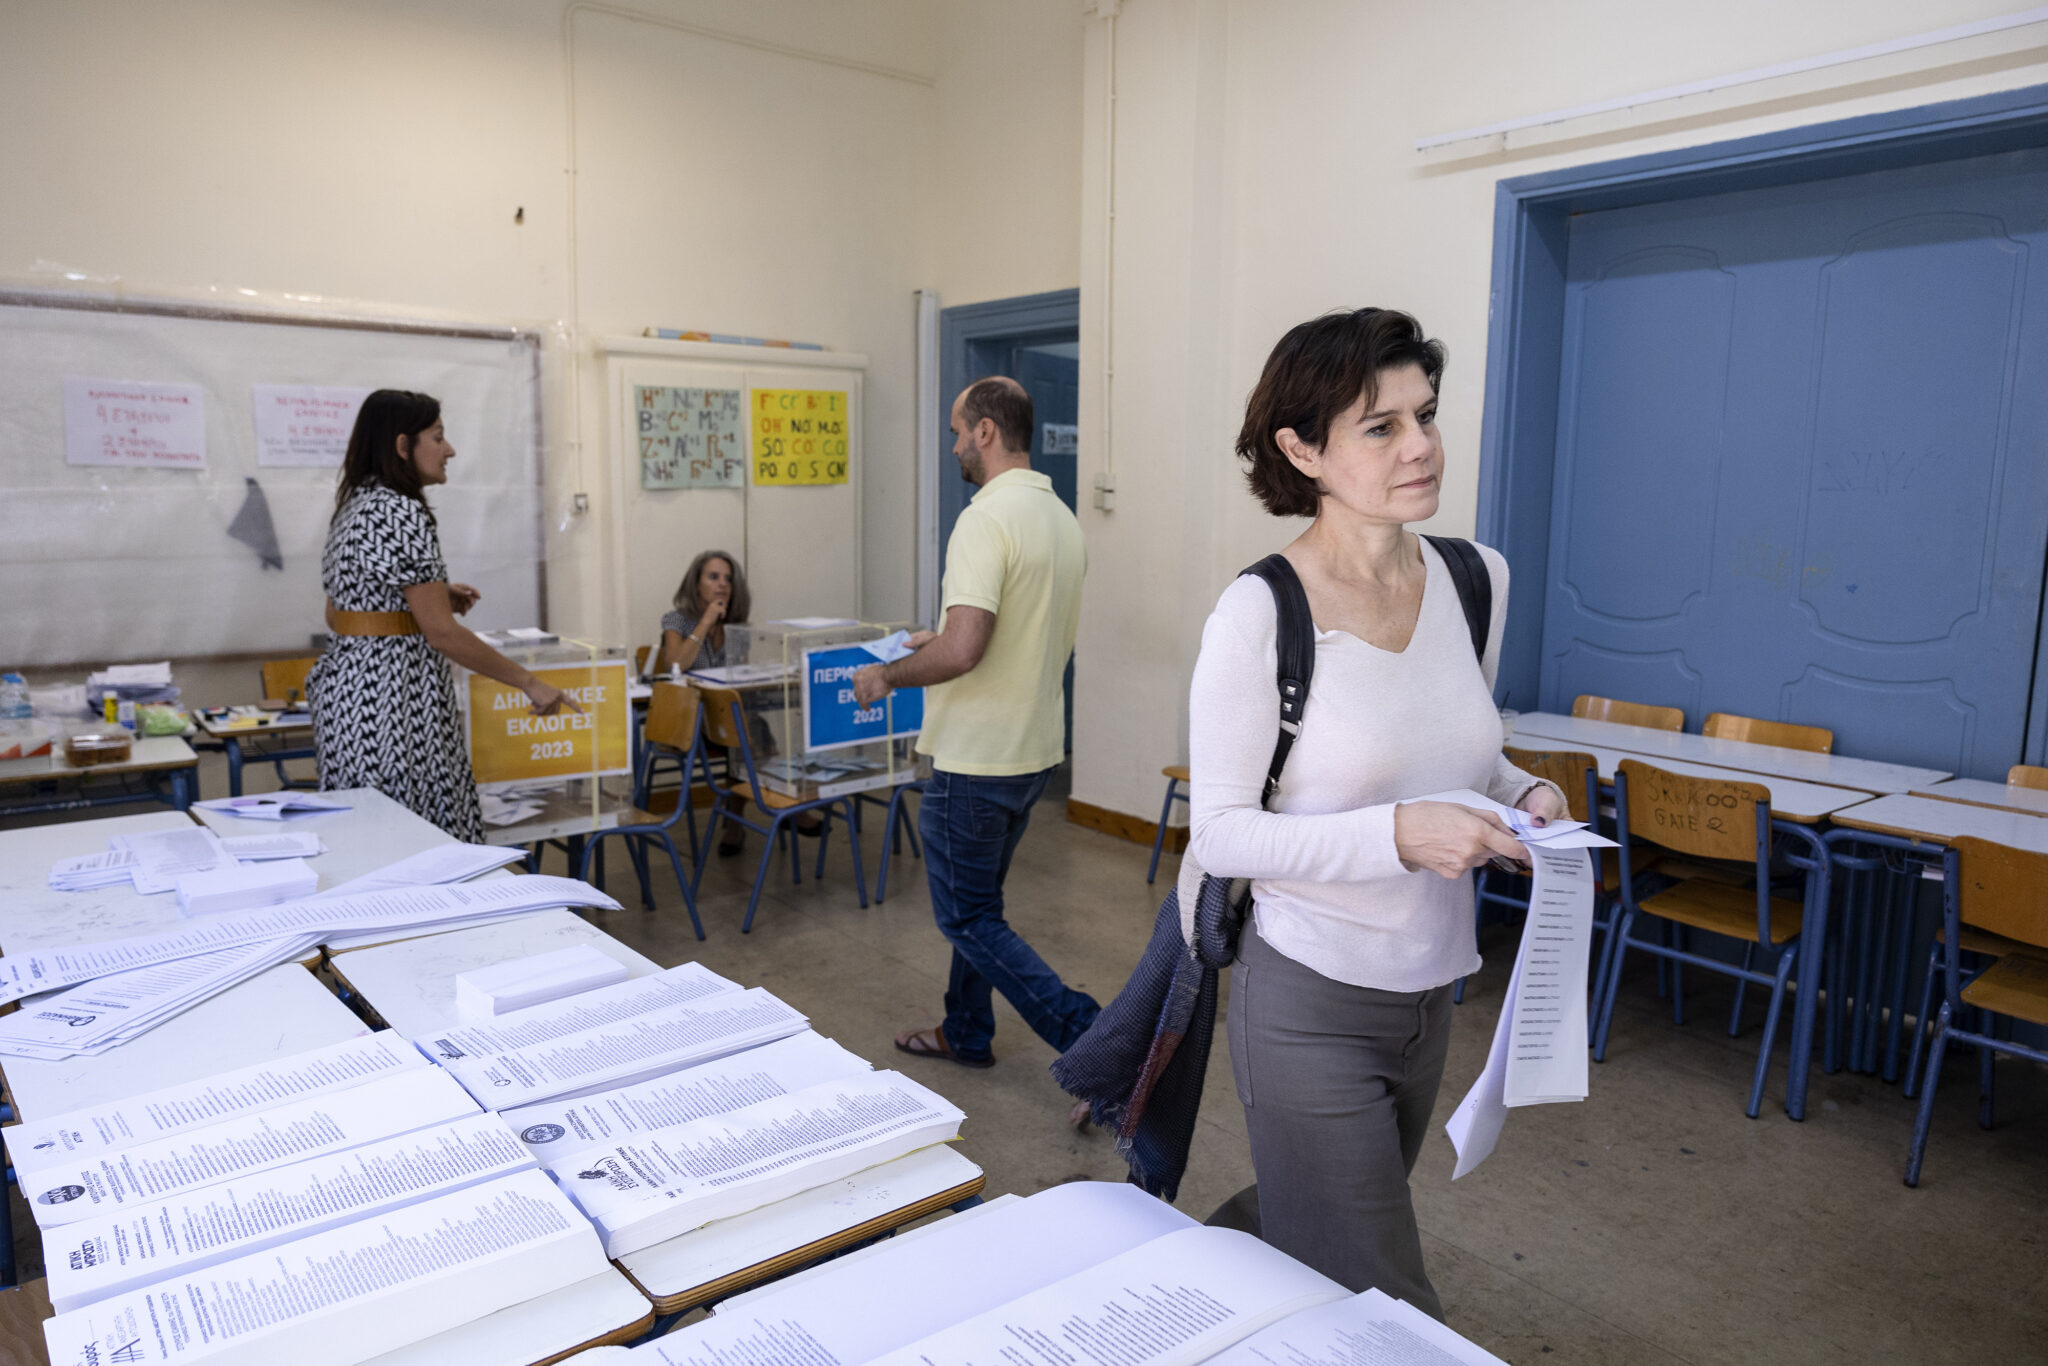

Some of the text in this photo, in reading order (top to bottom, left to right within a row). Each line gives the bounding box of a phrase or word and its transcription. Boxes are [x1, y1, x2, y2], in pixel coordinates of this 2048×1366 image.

[506, 712, 593, 736] ΕΚΛΟΓΕΣ
[853, 706, 884, 724] 2023
[530, 740, 574, 760] 2023
[1654, 808, 1698, 832] GATE
